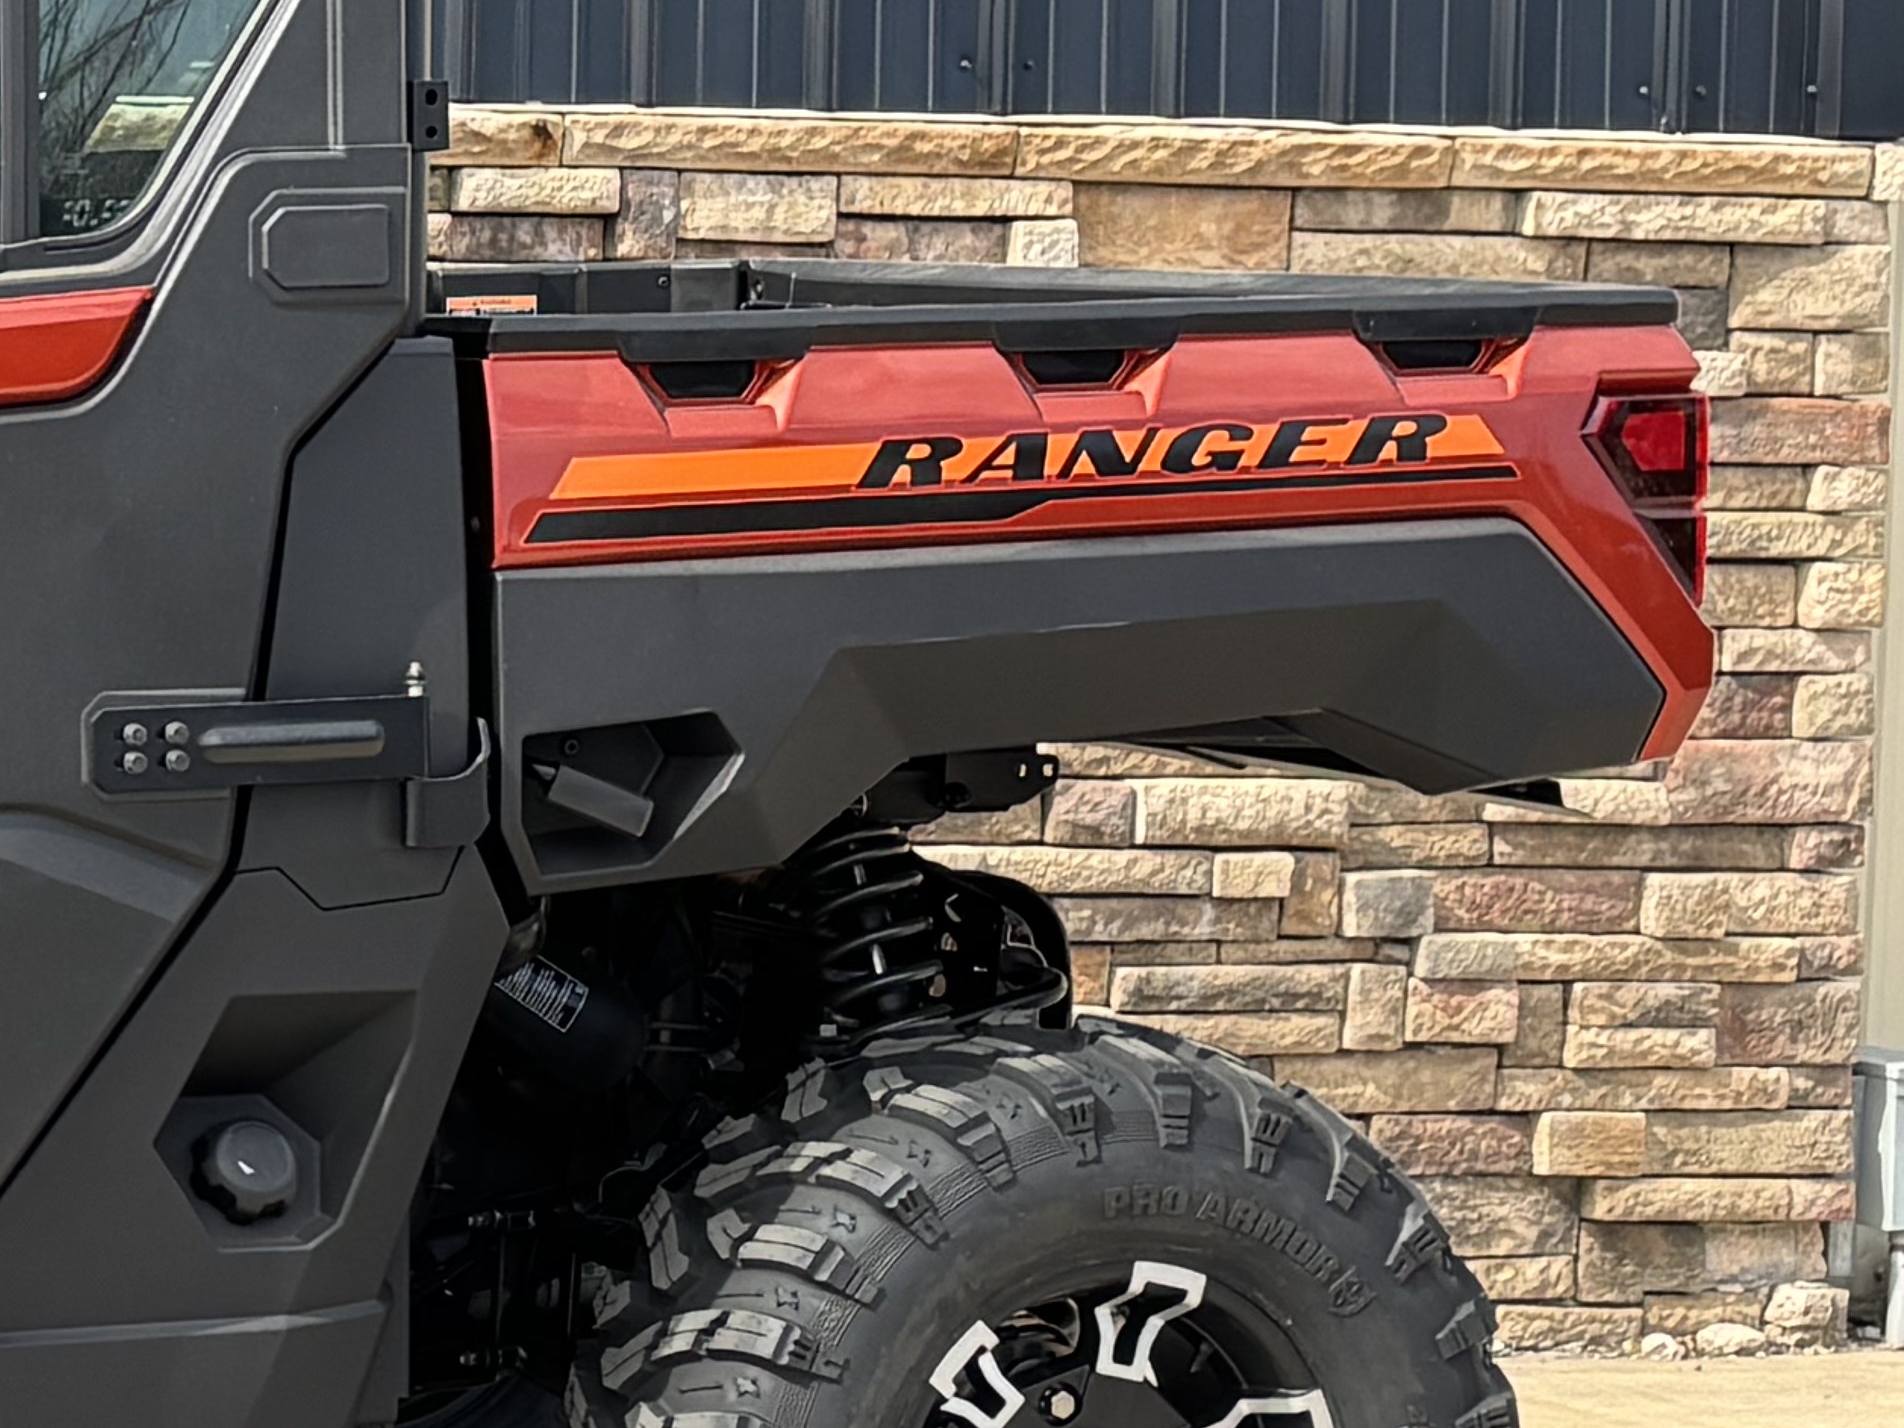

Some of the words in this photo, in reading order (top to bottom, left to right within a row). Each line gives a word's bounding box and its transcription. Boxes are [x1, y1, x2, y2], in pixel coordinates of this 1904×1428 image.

[854, 413, 1450, 490] RANGER
[1103, 1180, 1191, 1218] PRO
[1195, 1190, 1340, 1284] ARMOR
